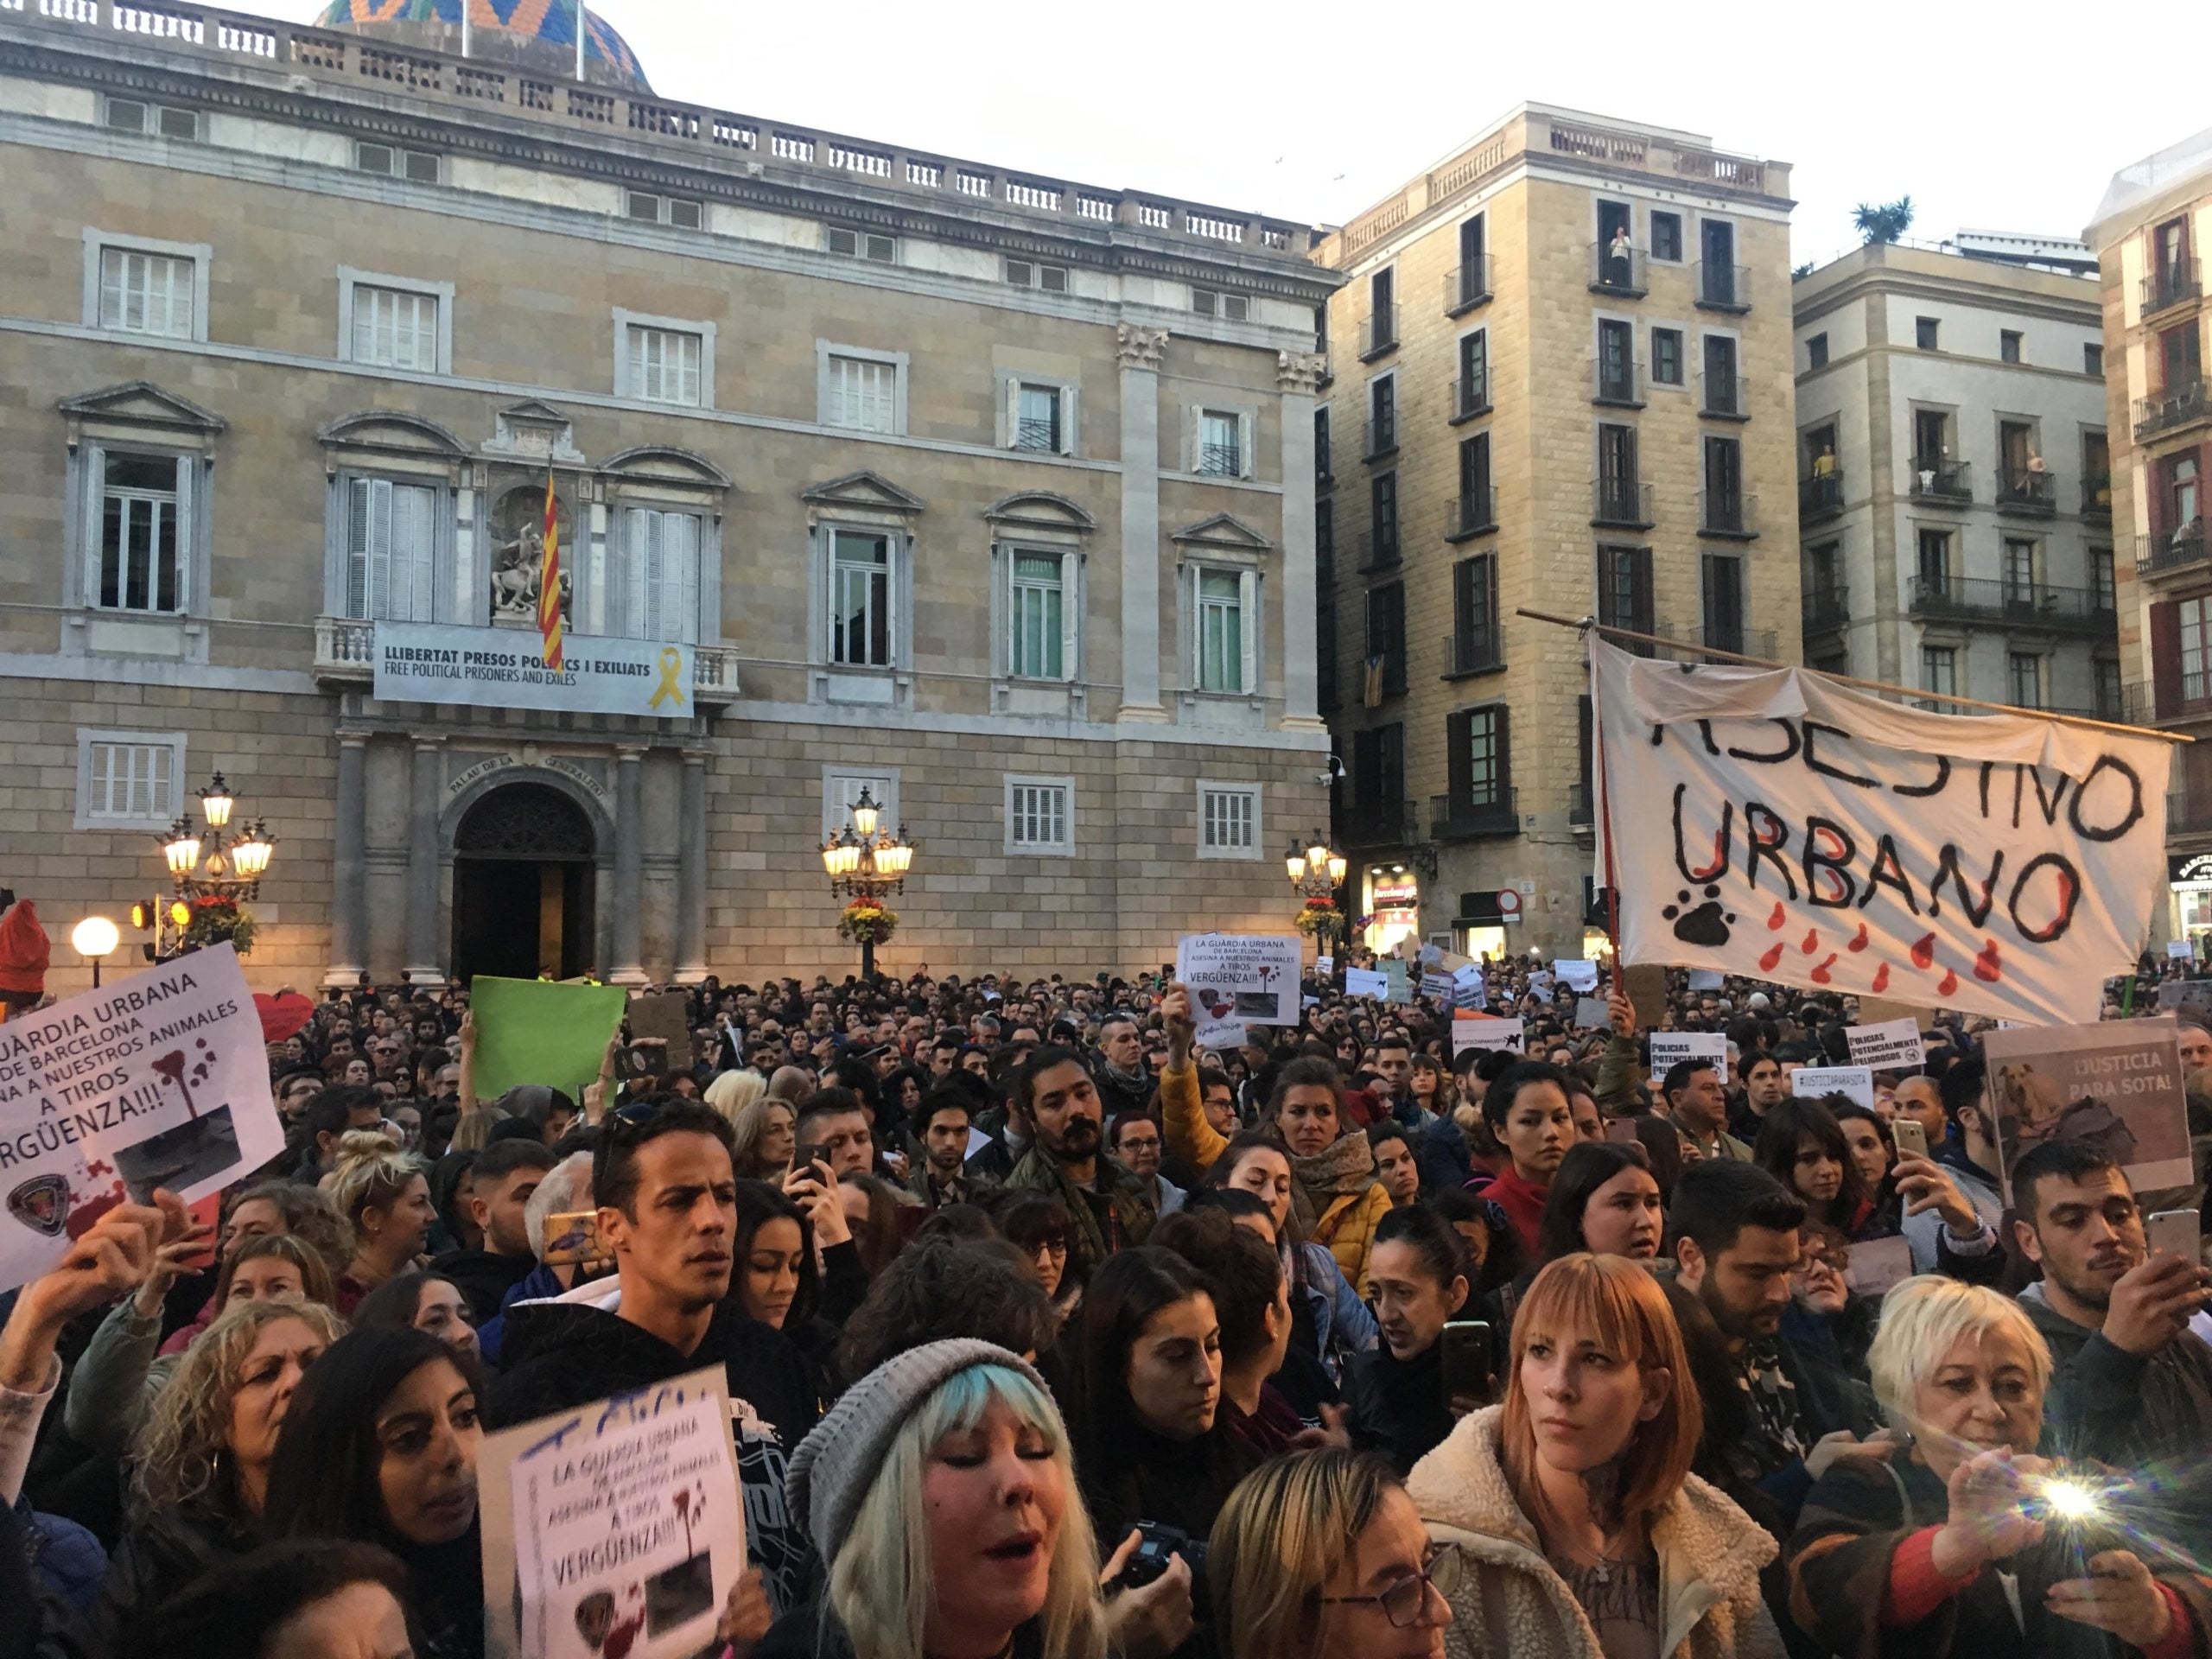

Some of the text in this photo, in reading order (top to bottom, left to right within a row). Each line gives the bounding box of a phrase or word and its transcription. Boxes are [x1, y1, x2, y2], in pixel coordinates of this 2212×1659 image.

[385, 646, 651, 677] LLIBERTAT PRESOS POLICS I EXILIATS
[385, 661, 576, 686] FREE POLITICAL PRISONERS AND EXILES
[450, 767, 480, 793] PALAU
[482, 760, 498, 772] DE
[501, 755, 514, 766] LA
[1674, 783, 2081, 943] URBANO
[2179, 855, 2212, 879] BARCE
[1191, 971, 1257, 983] VERGÜENZA!!!
[93, 973, 198, 1025] URBANA
[0, 1017, 143, 1082] DE BARCELONA
[29, 1078, 41, 1094] A
[44, 1032, 143, 1087] NUESTROS
[149, 999, 238, 1046] ANIMALES
[1652, 1044, 1690, 1052] POLICIAS
[1849, 1033, 1885, 1046] POLICIAS
[1852, 1039, 1919, 1057] POTENCIALMENTE
[1853, 1052, 1901, 1065] PELIGROSOS
[41, 1066, 130, 1116] A TIROS
[2069, 1074, 2171, 1100] PARA SOTA!
